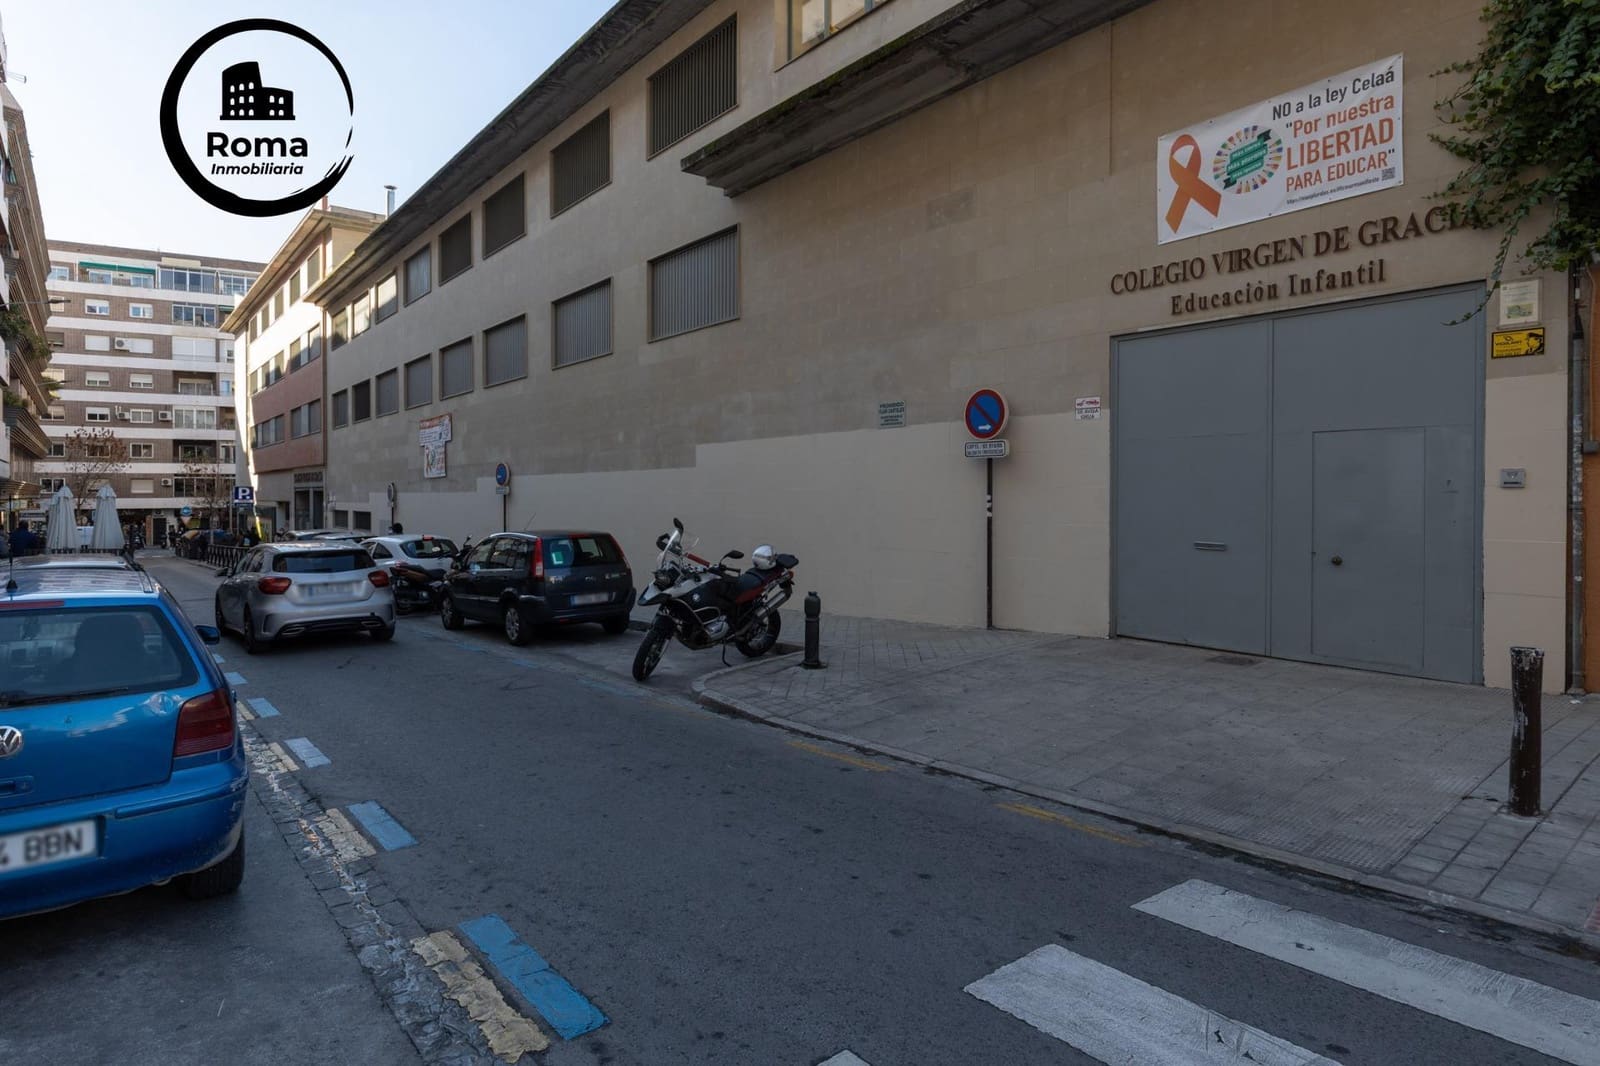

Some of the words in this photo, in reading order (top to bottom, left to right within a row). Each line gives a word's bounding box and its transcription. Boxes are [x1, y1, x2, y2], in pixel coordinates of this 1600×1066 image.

[1272, 102, 1291, 121] NO
[1295, 101, 1305, 113] a
[1308, 94, 1321, 109] la
[1325, 86, 1348, 104] ley
[1352, 67, 1395, 94] Celaá
[1327, 95, 1394, 128] nuestra
[1286, 118, 1394, 170] LIBERTAD
[1286, 170, 1322, 192] PARA
[1327, 149, 1395, 181] EDUCAR"
[1111, 256, 1206, 295] COLEGIO
[1211, 235, 1306, 275] VIRGEN
[1314, 224, 1350, 255] DE
[1171, 280, 1279, 315] Educación
[1288, 259, 1386, 297] Infantil
